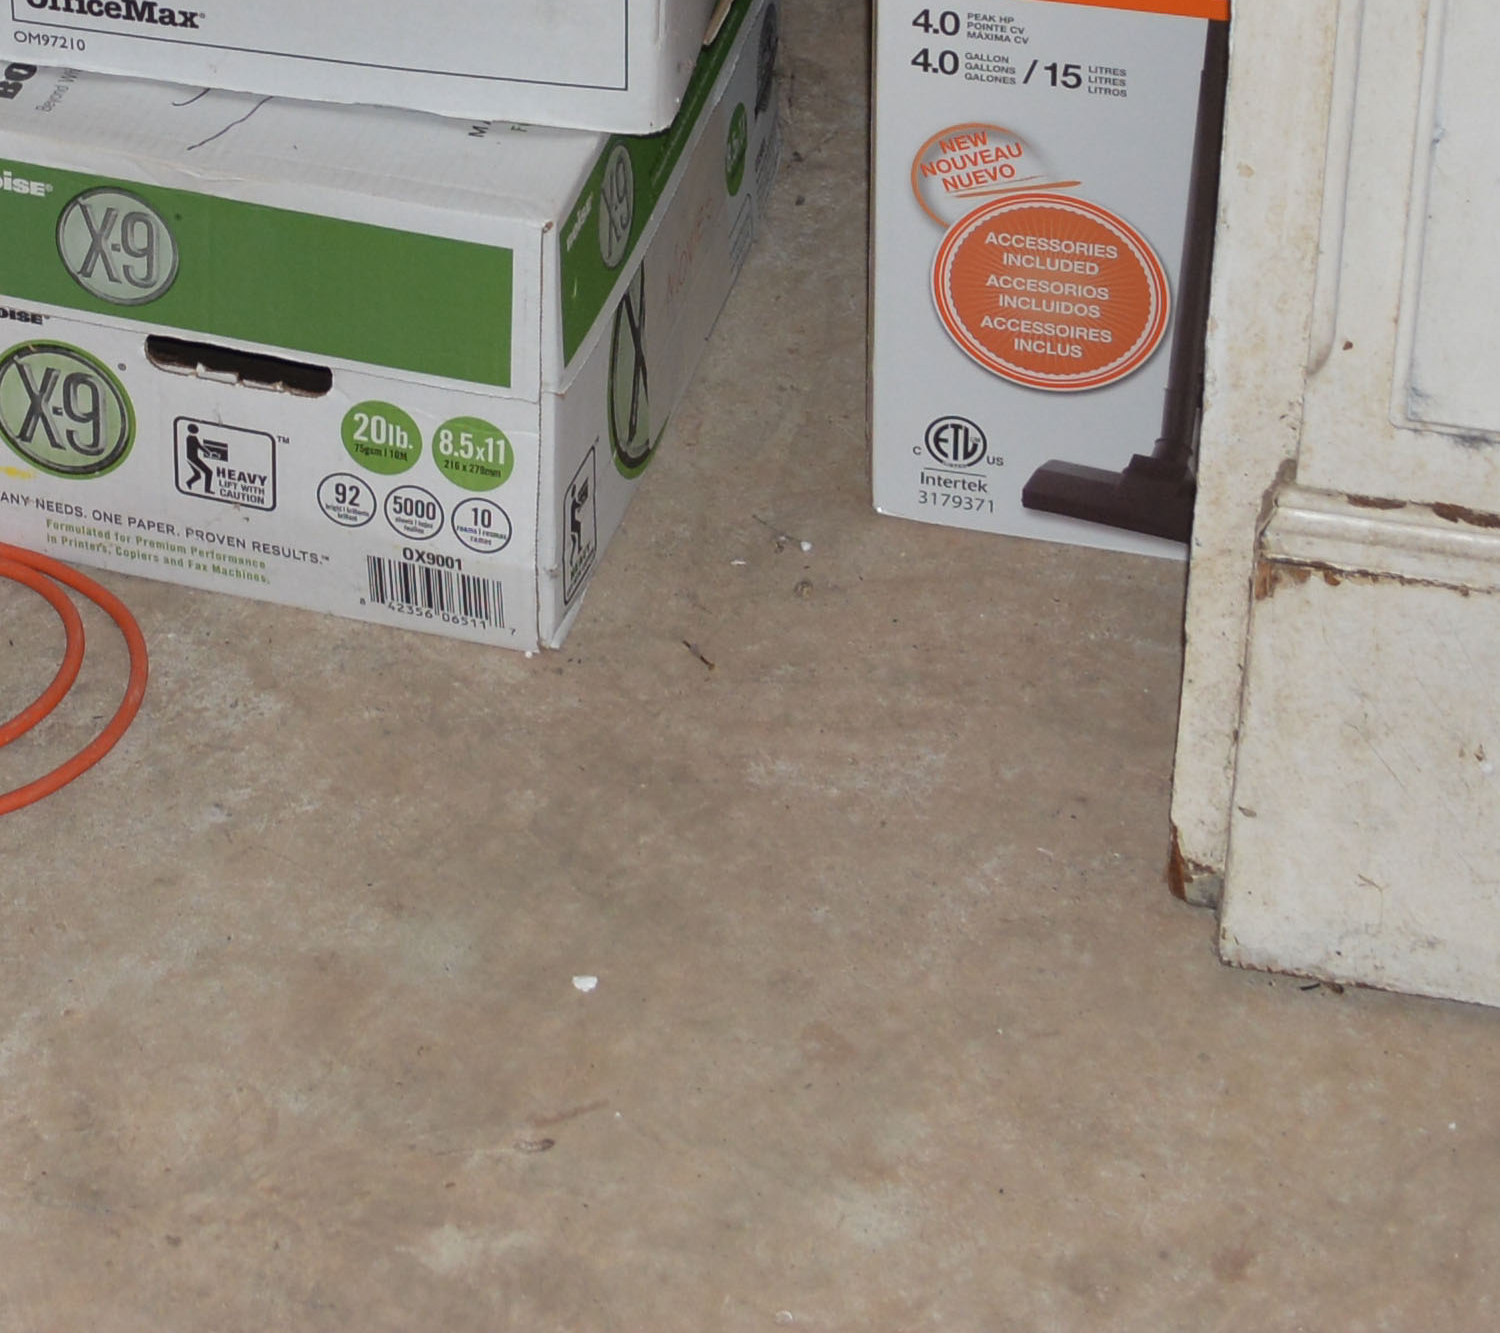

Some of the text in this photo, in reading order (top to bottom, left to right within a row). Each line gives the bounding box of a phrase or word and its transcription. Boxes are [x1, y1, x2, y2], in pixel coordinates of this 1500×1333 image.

[912, 9, 960, 36] 4.0
[967, 12, 1014, 24] PEAK HP
[967, 21, 1025, 35] POINTE CV
[13, 30, 86, 51] OM97210
[1014, 35, 1029, 45] CV
[911, 47, 960, 75] 4.0
[964, 51, 1009, 64] GALLON
[964, 62, 1016, 75] GALLONS
[964, 72, 1017, 85] GALONES
[1044, 62, 1083, 89] 15
[1088, 65, 1127, 77] LITRES
[1088, 75, 1126, 87] LITRES
[1087, 85, 1128, 98] LITROS
[939, 131, 988, 154] NEW
[919, 142, 1024, 178] NOUVEAU
[941, 163, 1016, 193] NUEVO
[77, 198, 160, 290] X-9
[984, 231, 1118, 260] ACCESSORIES
[1002, 252, 1100, 276] INCLUDED
[985, 274, 1110, 301] ACCESORIOS
[998, 293, 1101, 319] INCLUIDOS
[980, 315, 1113, 344] ACCESSOIRES
[1013, 337, 1083, 359] INCLUS
[12, 354, 108, 457] X-9
[353, 413, 414, 450] 20lb.
[443, 459, 460, 473] 216
[986, 455, 1004, 466] US
[216, 466, 267, 487] HEAVY
[218, 479, 265, 496] LIFT WITH
[920, 471, 988, 493] Intertek
[219, 488, 265, 505] CAUTION
[334, 483, 361, 507] 92
[918, 490, 994, 514] 3179371
[392, 496, 436, 521] 5000
[471, 507, 492, 528] 10
[35, 498, 88, 519] NEEDS.
[92, 509, 123, 526] ONE
[128, 516, 181, 538] PAPER.
[185, 526, 246, 550] PROVEN
[46, 519, 266, 570] Formulated for Premium Performance
[115, 546, 159, 564] Copiers
[163, 555, 184, 568] and
[187, 559, 208, 572] Fax
[211, 561, 271, 585] Machines.
[388, 601, 433, 620] 42356
